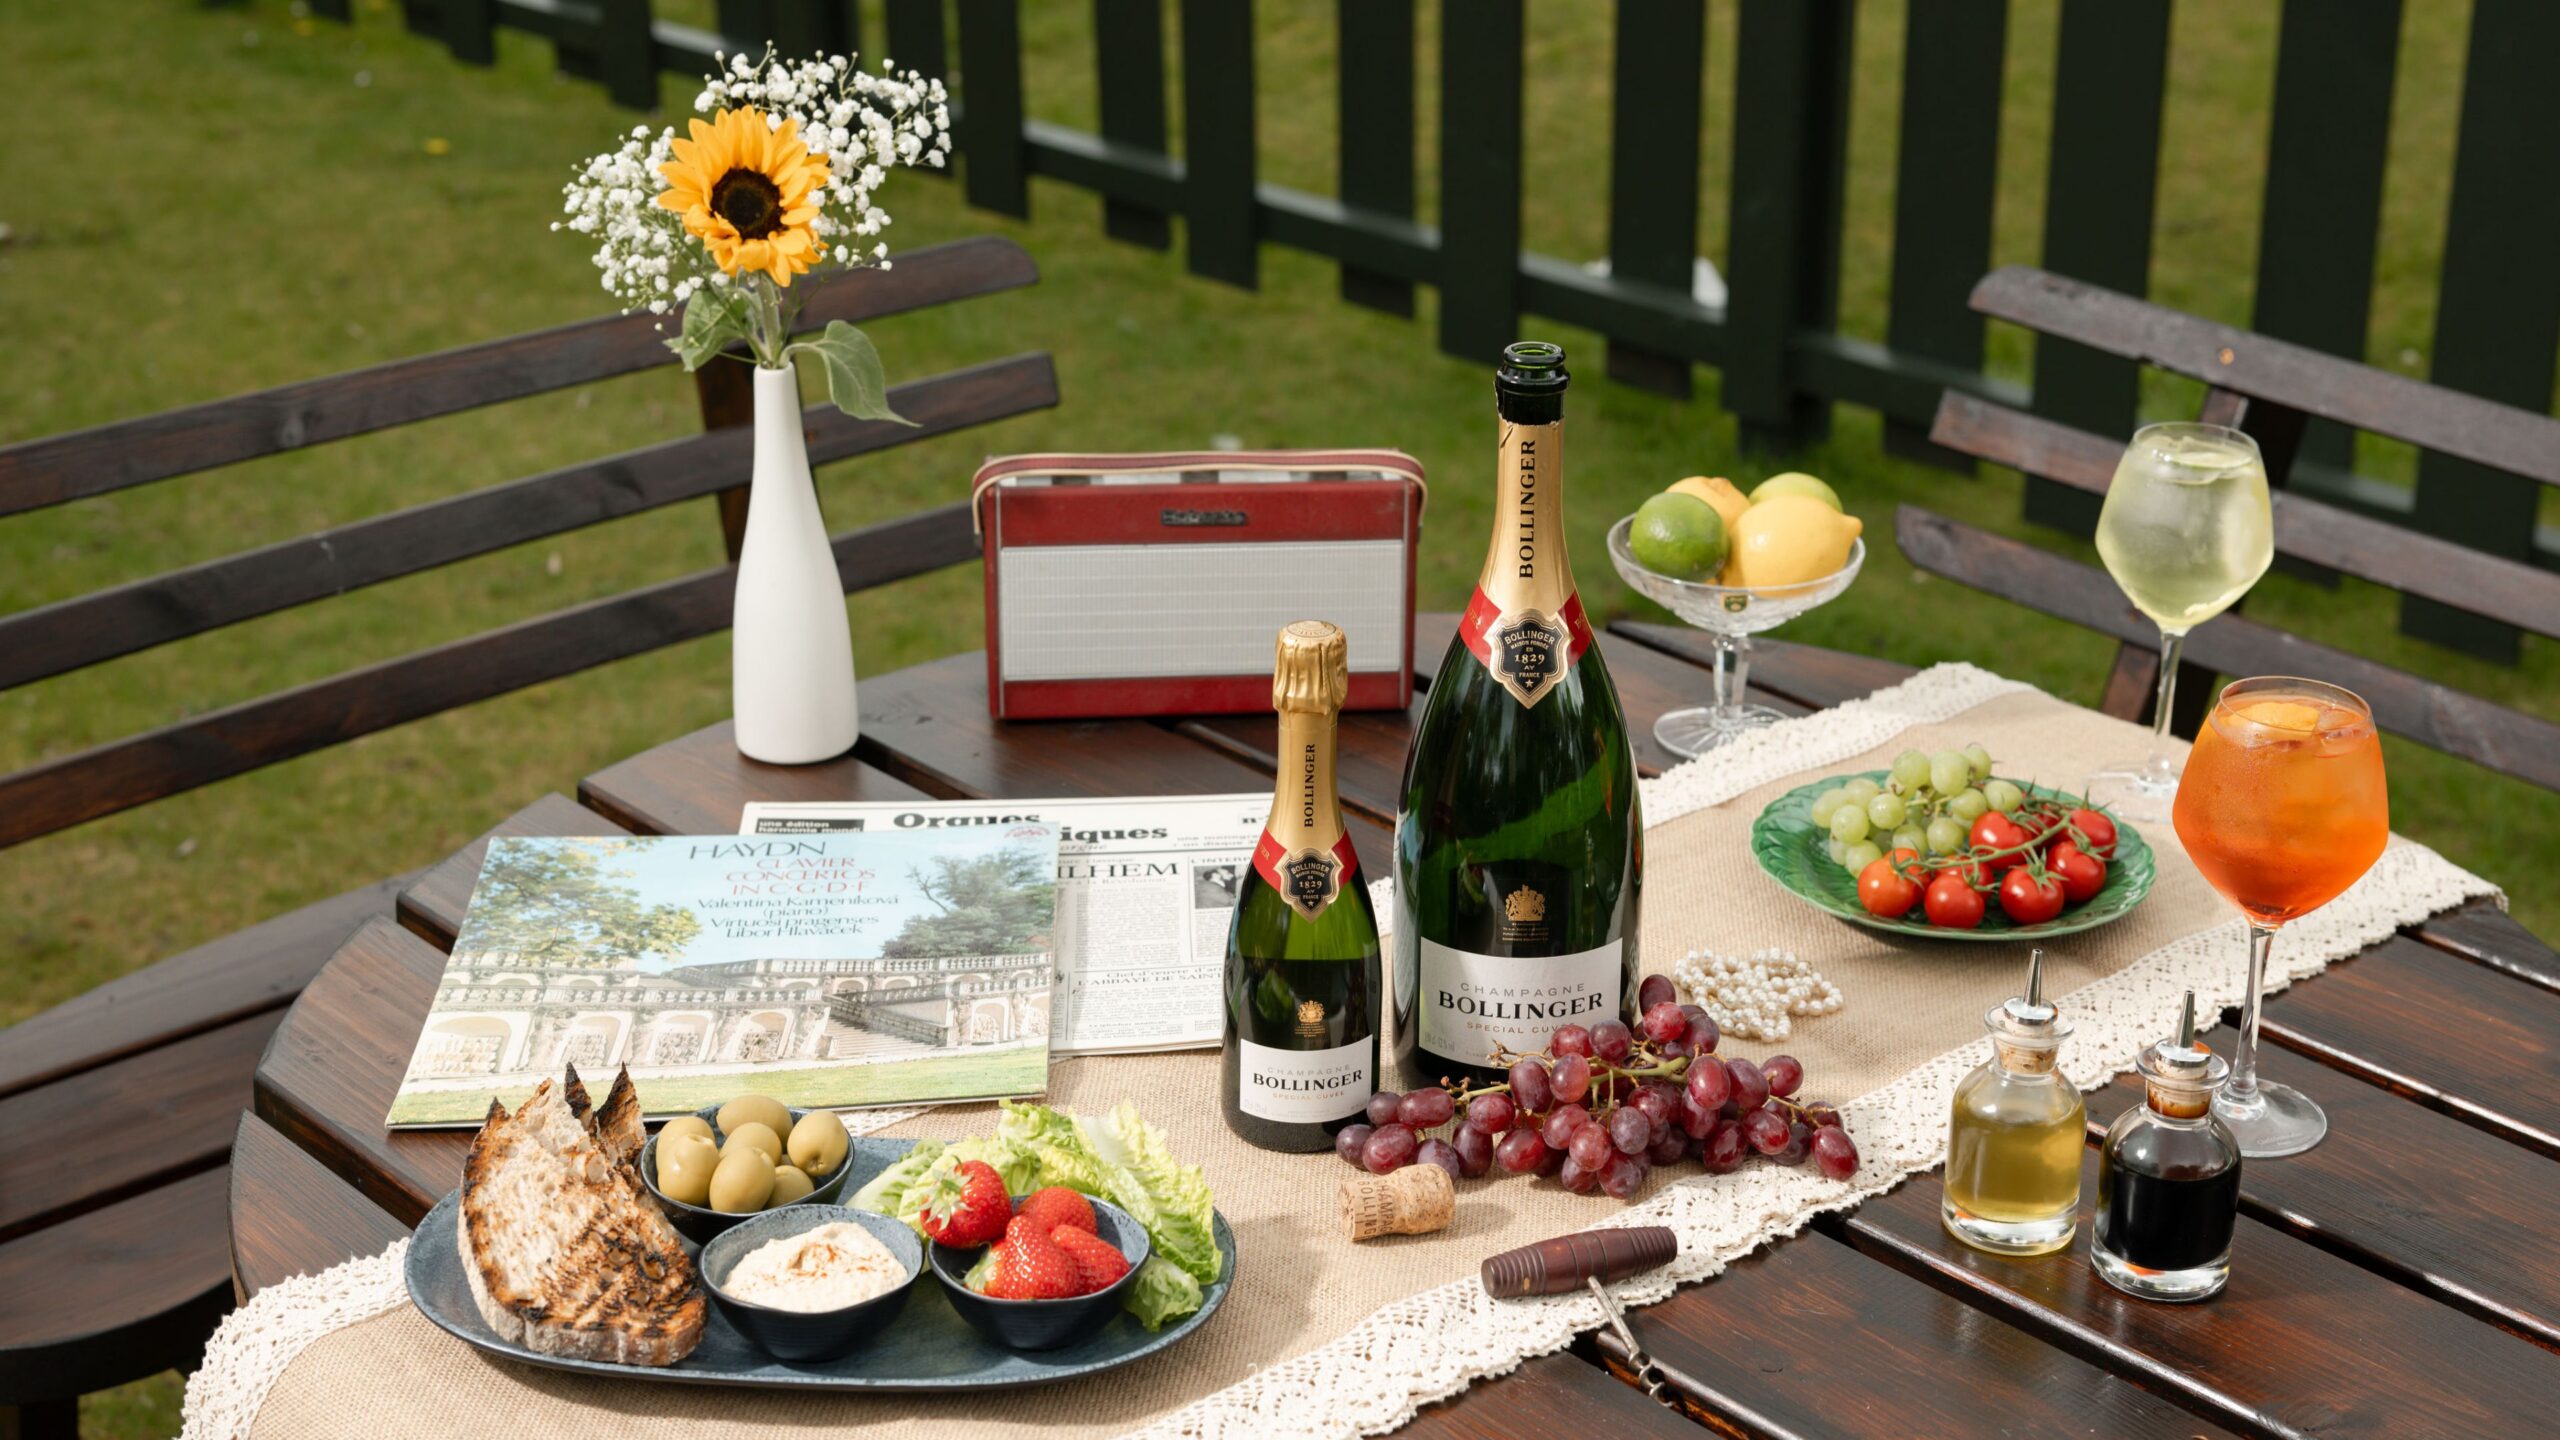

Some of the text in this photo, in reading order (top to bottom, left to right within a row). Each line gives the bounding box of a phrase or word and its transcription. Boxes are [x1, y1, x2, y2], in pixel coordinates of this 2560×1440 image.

[1519, 440, 1536, 579] BOLLINGER
[1504, 630, 1555, 645] BOLLINGER
[1510, 640, 1530, 650] MAISON
[1514, 654, 1545, 665] 1829
[1303, 743, 1315, 828] BOLLINGER
[785, 819, 829, 828] édition
[690, 841, 826, 859] HAYDN
[757, 858, 856, 869] CLAVIER
[1291, 863, 1330, 874] BOLLINGER
[726, 868, 877, 882] CONCERTOS
[733, 883, 760, 896] IN
[1299, 880, 1322, 889] 1829
[698, 897, 782, 909] Valentina
[762, 905, 829, 920] (piano)
[710, 915, 879, 930] Virtuosi pragenses
[726, 926, 773, 938] Libor
[1460, 982, 1585, 998] CHAMPAGNE
[1438, 990, 1603, 1020] BOLLINGER
[1467, 1021, 1524, 1034] SPECIAL
[1267, 1064, 1350, 1077] CHAMPAGNE
[1253, 1069, 1362, 1091] BOLLINGER
[1272, 1092, 1312, 1101] SPECIAL
